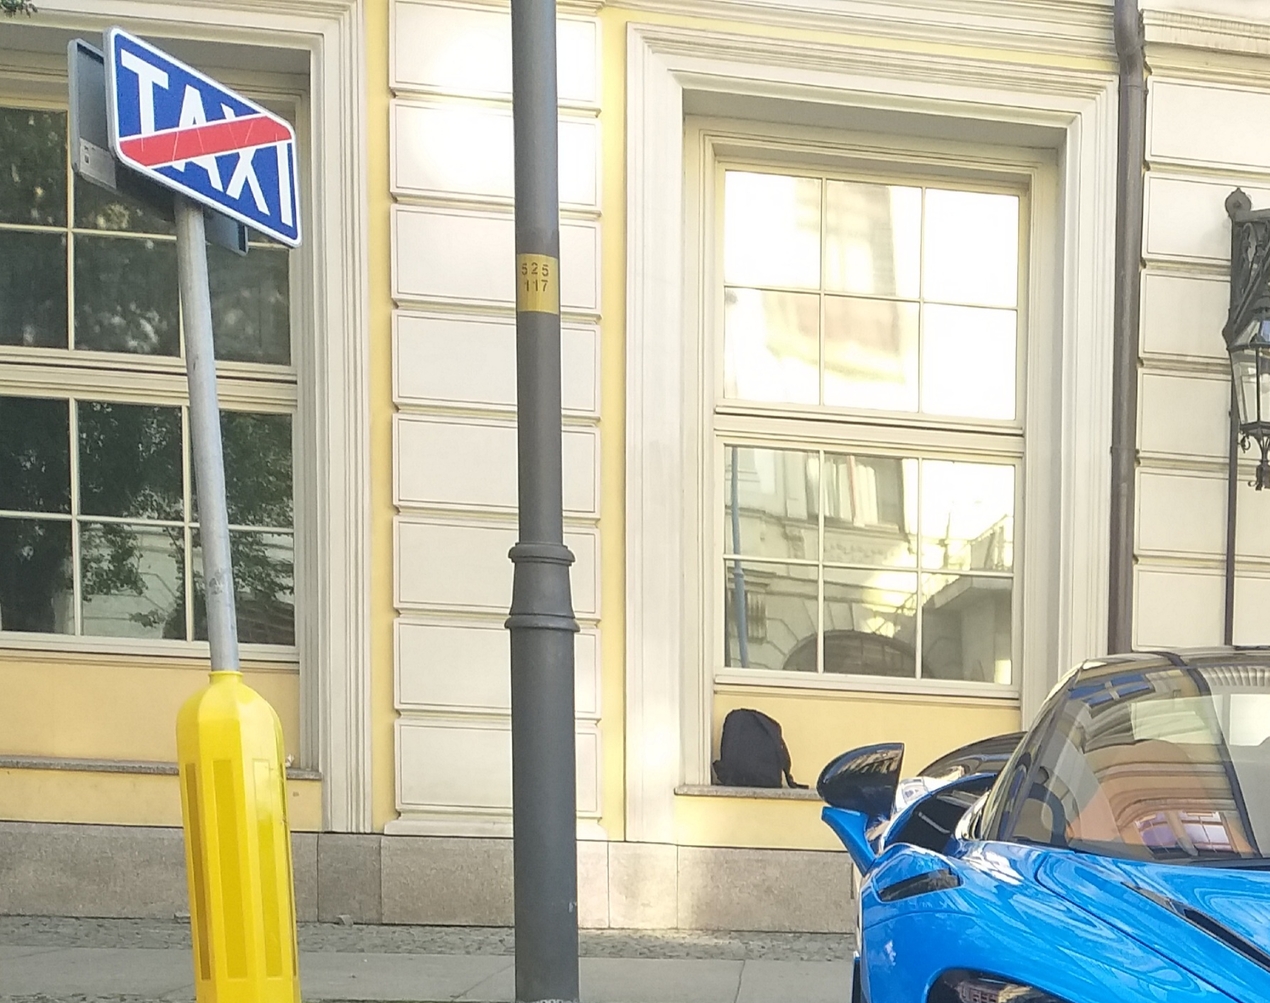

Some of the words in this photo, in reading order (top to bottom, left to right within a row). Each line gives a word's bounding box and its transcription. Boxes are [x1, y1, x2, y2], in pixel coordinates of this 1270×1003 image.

[120, 48, 293, 228] TAXI
[521, 262, 549, 277] 525
[524, 279, 548, 291] 117
